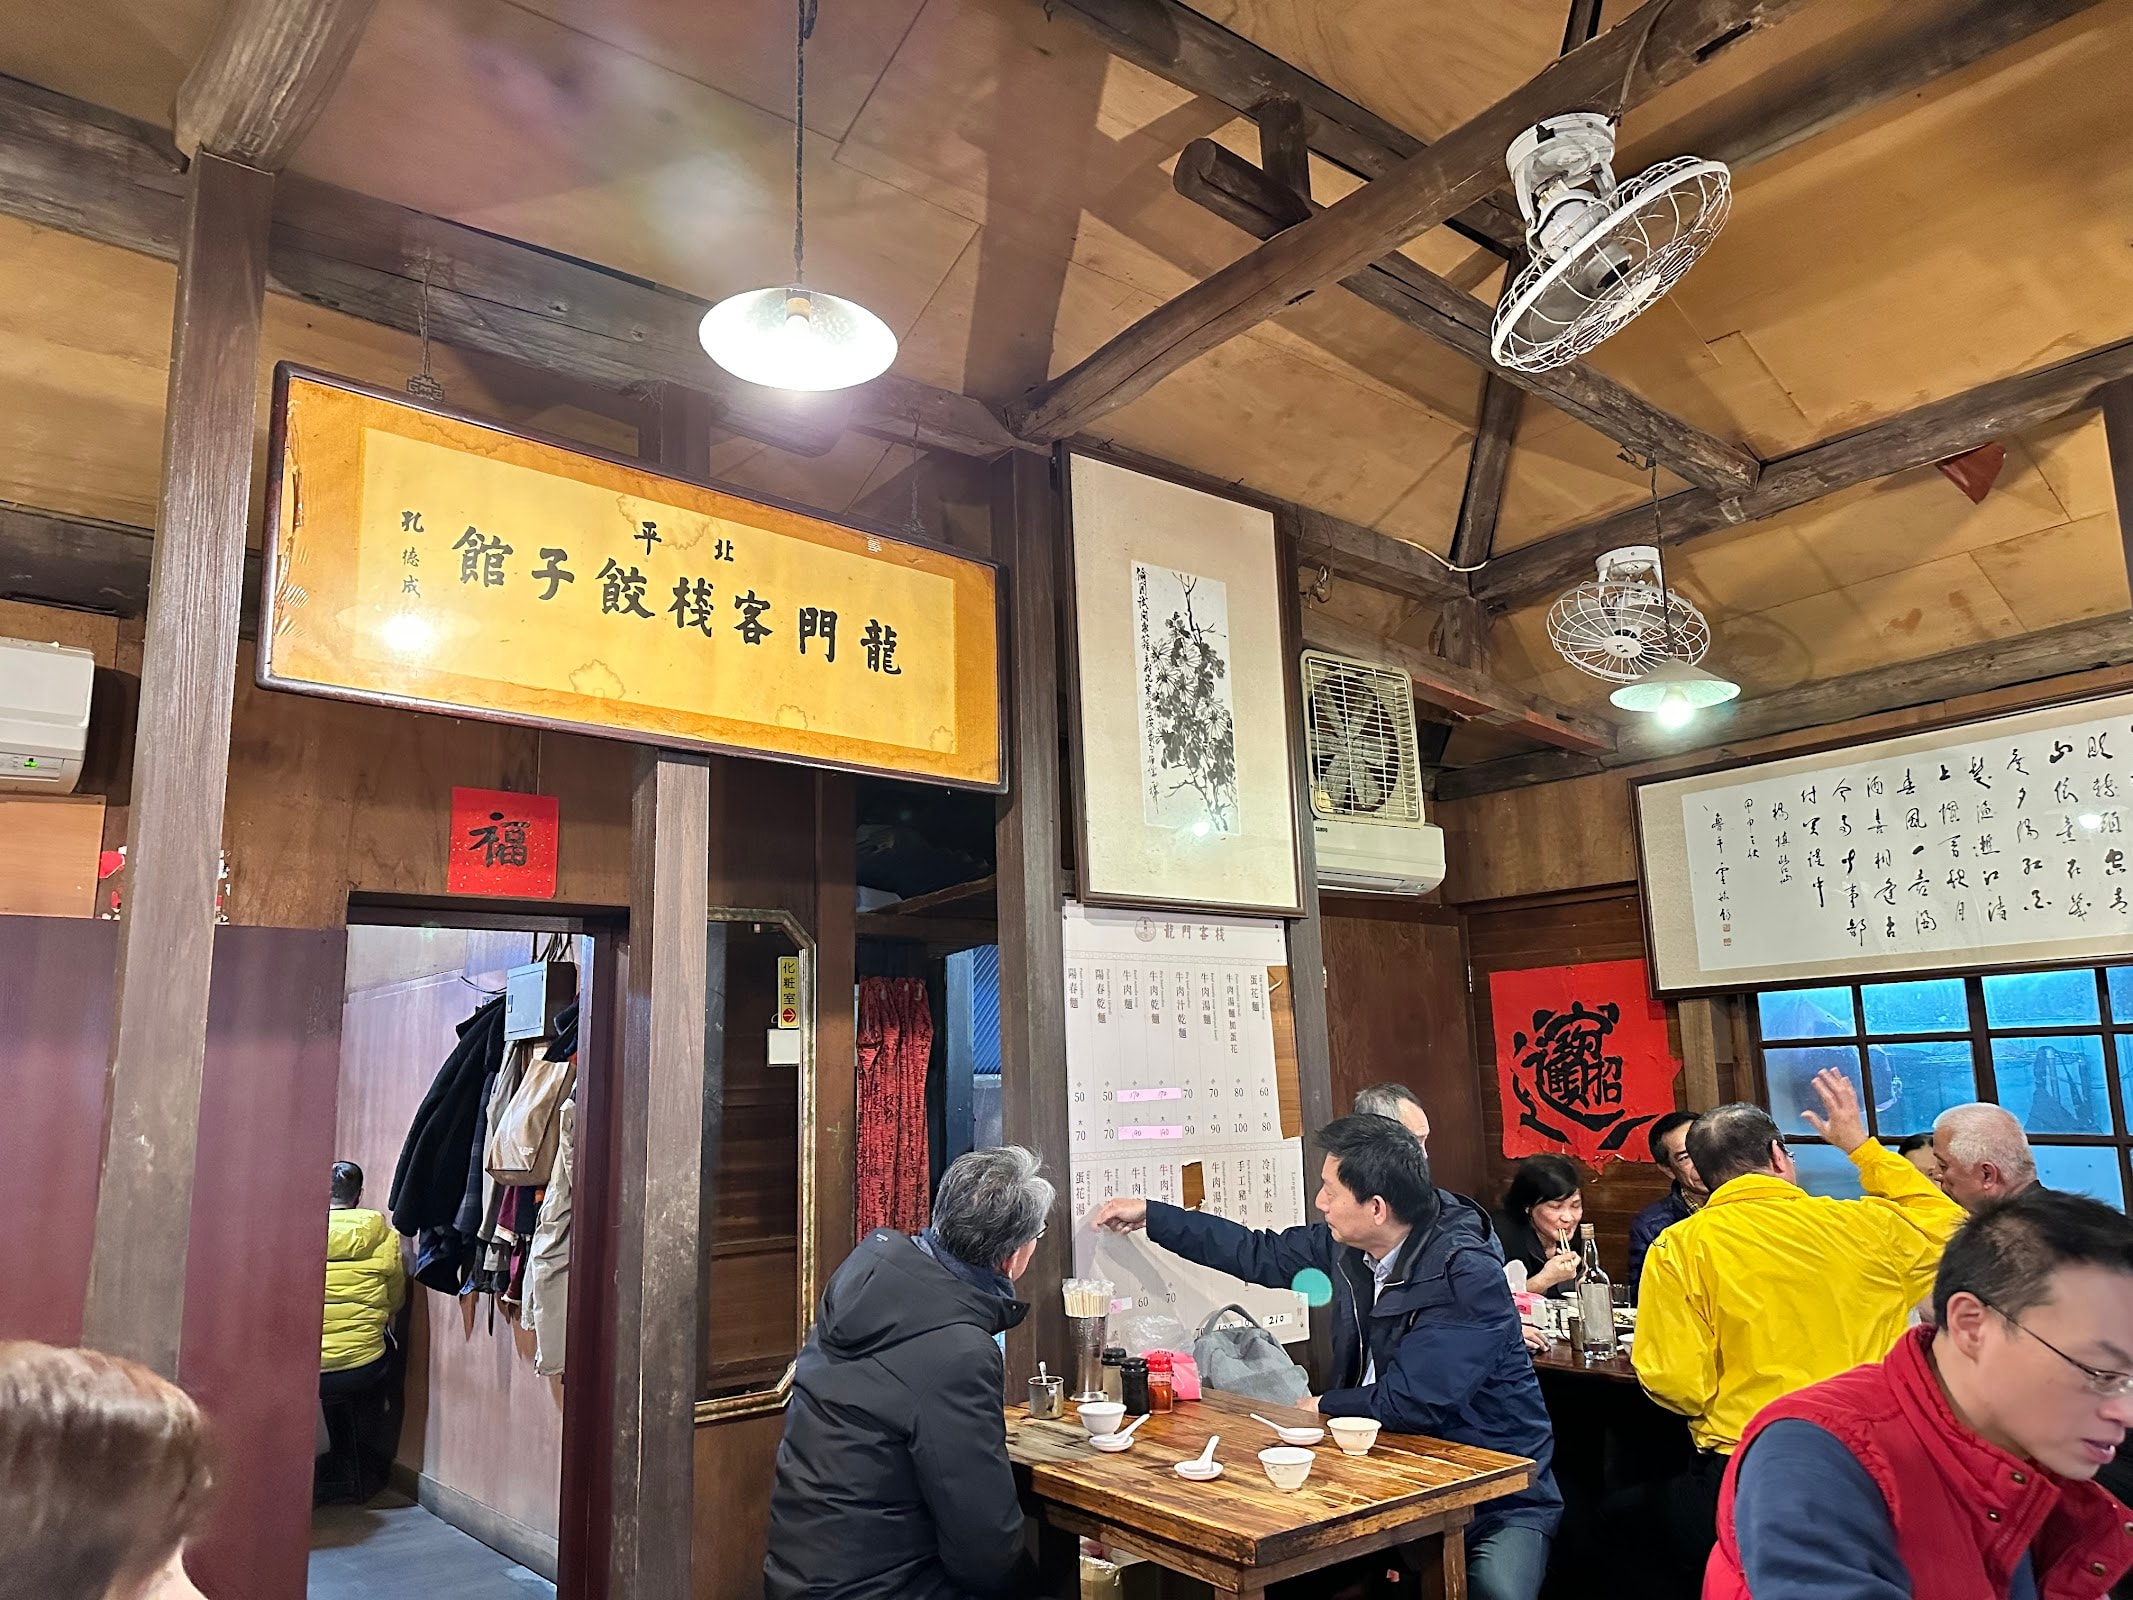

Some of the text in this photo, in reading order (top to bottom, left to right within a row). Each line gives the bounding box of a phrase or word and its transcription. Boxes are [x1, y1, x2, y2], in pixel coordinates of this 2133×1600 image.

[451, 525, 903, 675] 龍門客棧餃子館
[468, 811, 531, 868] 福
[1164, 922, 1225, 942] 龍門客棧
[783, 962, 795, 1005] 化粧室
[1074, 1092, 1085, 1102] 50
[1102, 1091, 1113, 1102] 50
[1183, 1089, 1193, 1098] 70
[1209, 1088, 1219, 1097] 70
[1234, 1088, 1244, 1097] 80
[1259, 1087, 1269, 1097] 60
[1184, 1125, 1195, 1135] 90
[1210, 1124, 1220, 1134] 90
[1234, 1123, 1248, 1133] 100
[1262, 1122, 1271, 1132] 80
[1075, 1130, 1086, 1141] 70
[1104, 1129, 1114, 1140] 70
[1138, 1296, 1149, 1308] 60
[1166, 1292, 1177, 1304] 70
[1268, 1315, 1285, 1325] 210
